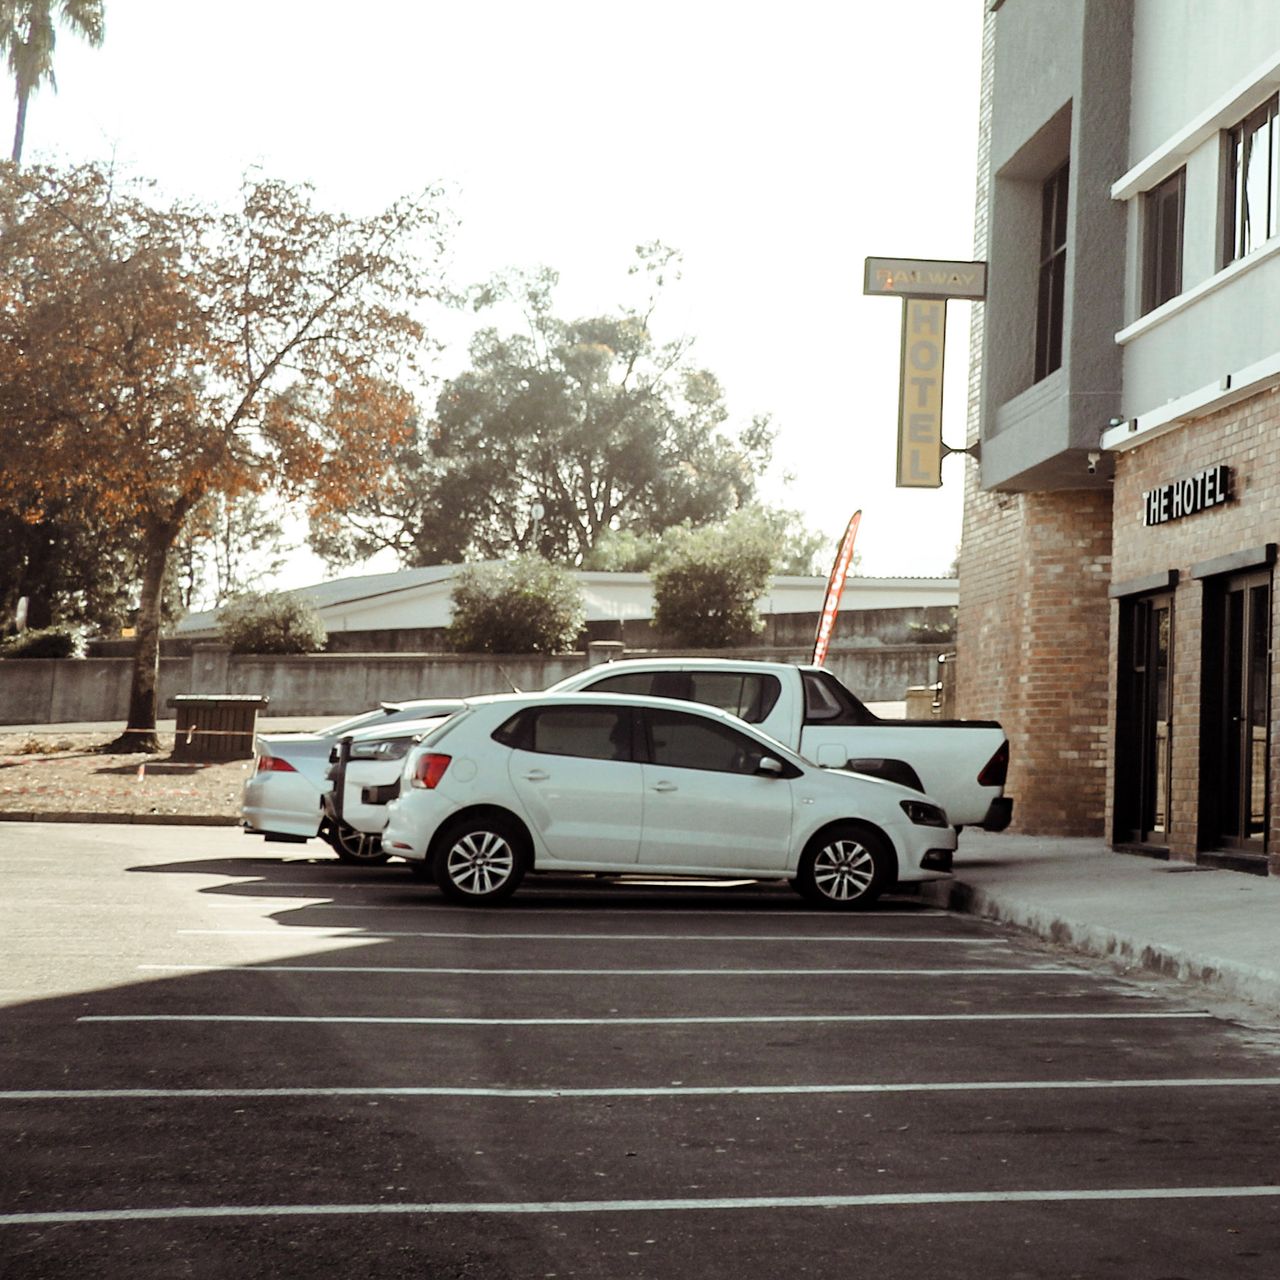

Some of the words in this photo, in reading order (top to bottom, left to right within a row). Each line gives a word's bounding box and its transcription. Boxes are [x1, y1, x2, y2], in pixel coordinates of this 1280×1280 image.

[910, 304, 940, 480] HOTEL
[1142, 486, 1170, 526] THE
[1172, 466, 1226, 519] HOTEL
